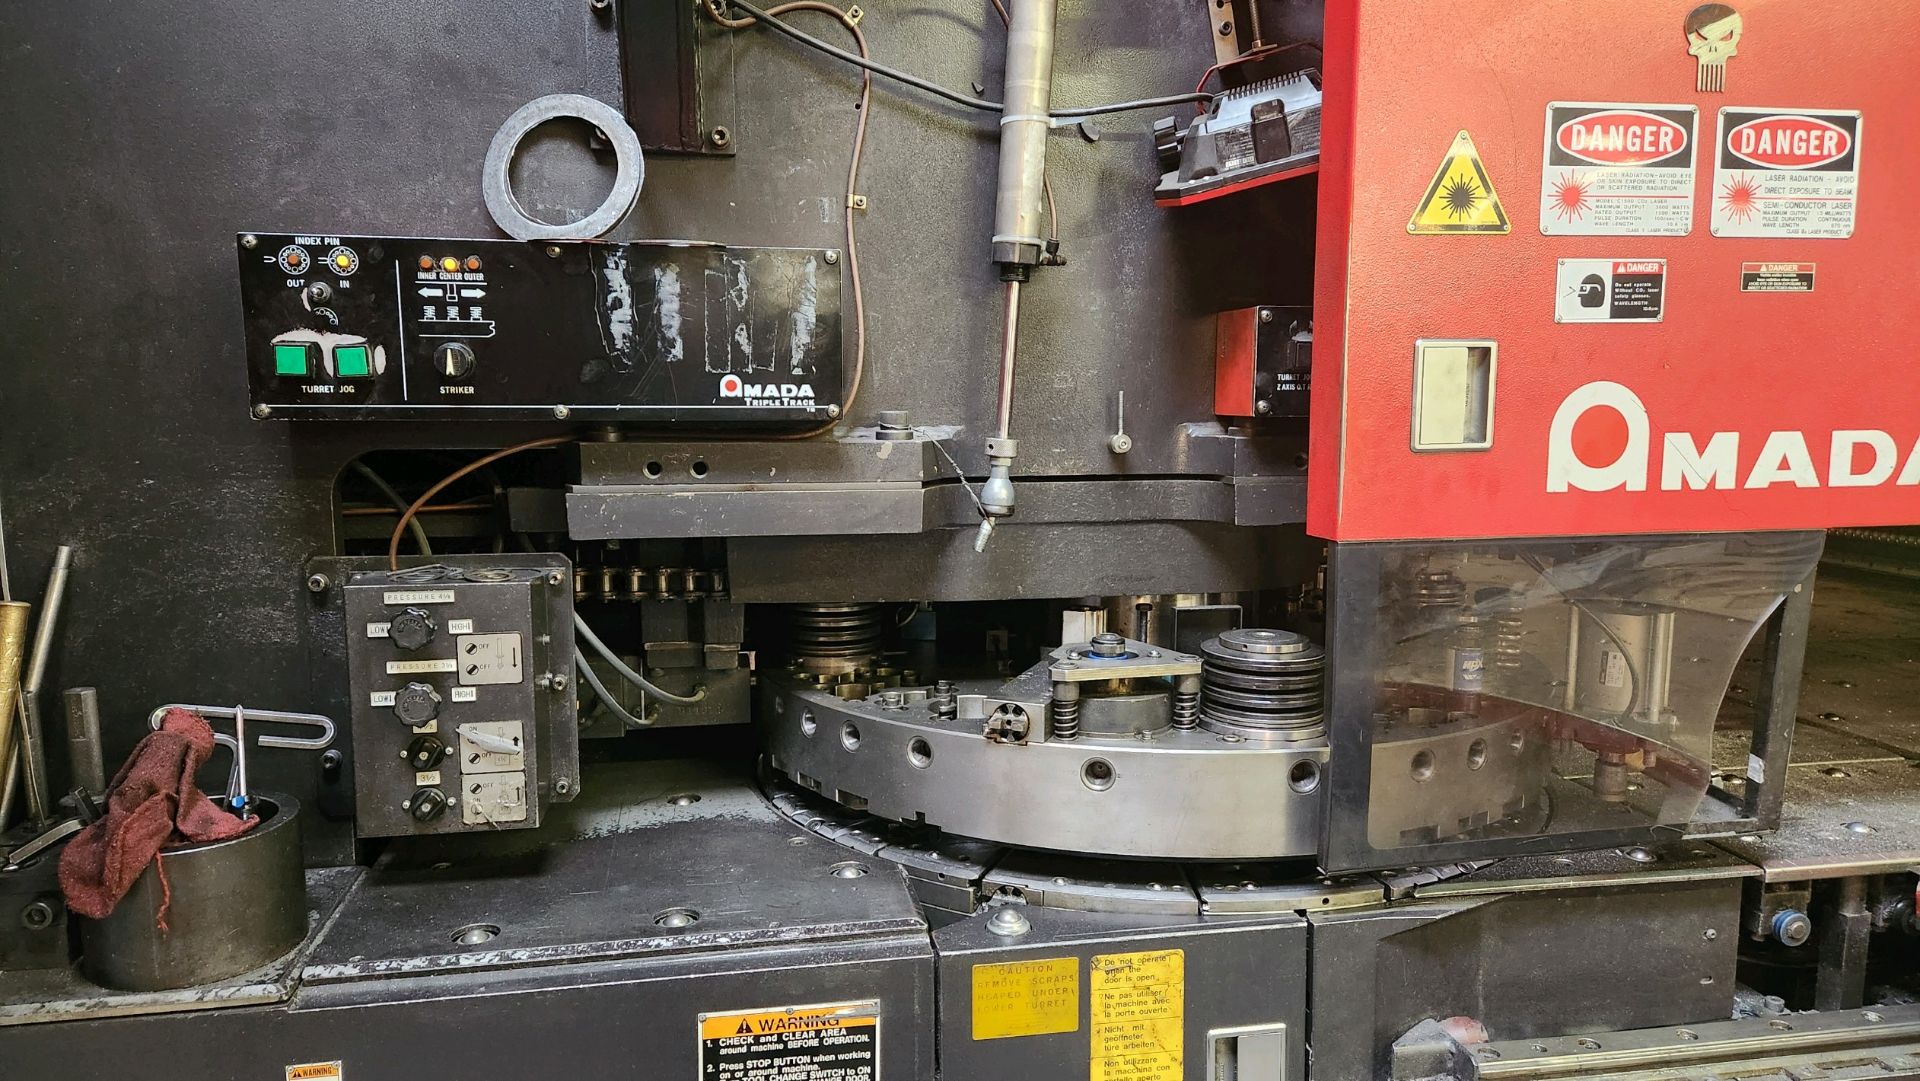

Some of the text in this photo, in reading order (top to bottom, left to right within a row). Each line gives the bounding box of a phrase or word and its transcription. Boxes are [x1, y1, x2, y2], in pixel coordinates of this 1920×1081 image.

[1571, 124, 1674, 152] DANGER
[1741, 128, 1838, 156] DANGER
[295, 237, 340, 246] INDEX PIN
[1627, 263, 1658, 272] DANGER
[418, 272, 484, 281] INNER CENTER OUTER
[287, 280, 350, 288] OUT IN
[720, 374, 815, 397] AMADA
[1138, 955, 1166, 965] operate
[999, 965, 1053, 975] CAUTION
[977, 975, 1074, 989] REMOVE SCRAPS
[1032, 987, 1068, 997] UNDER
[1116, 1010, 1134, 1018] porte
[759, 1016, 840, 1032] WARNING
[719, 1036, 754, 1046] CHECK
[760, 1033, 777, 1042] and
[782, 1031, 815, 1041] CLEAR
[820, 1028, 847, 1037] AREA
[720, 1035, 870, 1055] around machine BEFORE OPERATION.
[707, 1051, 871, 1073] 2. Press STOP BUTTON when working
[1124, 1057, 1157, 1065] utilizzare
[303, 1067, 332, 1076] WARNING
[748, 1068, 778, 1077] around
[782, 1064, 820, 1074] machine.
[770, 1072, 808, 1081] CHANGE
[810, 1068, 844, 1077] SWITCH
[857, 1066, 871, 1074] ON
